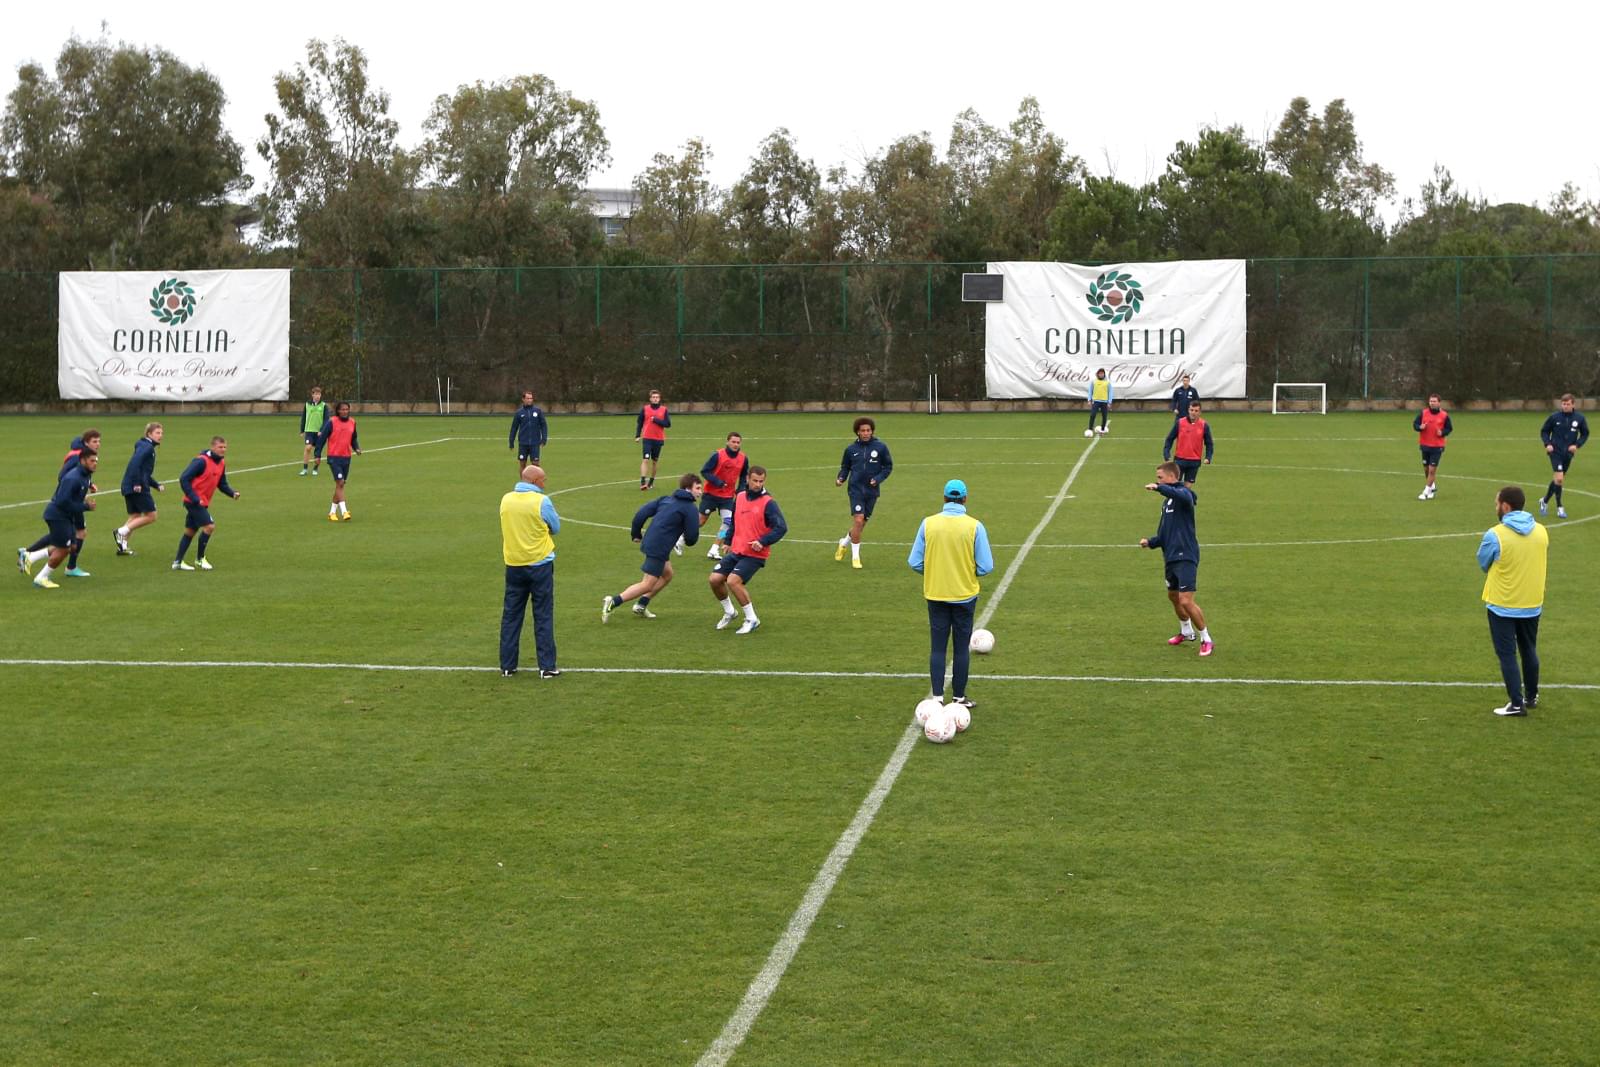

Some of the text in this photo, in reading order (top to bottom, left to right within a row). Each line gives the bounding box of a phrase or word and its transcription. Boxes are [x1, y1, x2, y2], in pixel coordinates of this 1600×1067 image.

[113, 329, 228, 353] CORNELIA
[1045, 327, 1185, 355] CORNELIA
[100, 357, 239, 378] De Luxe Resort
[1032, 358, 1090, 383] Hotels
[1107, 361, 1148, 389] Golf
